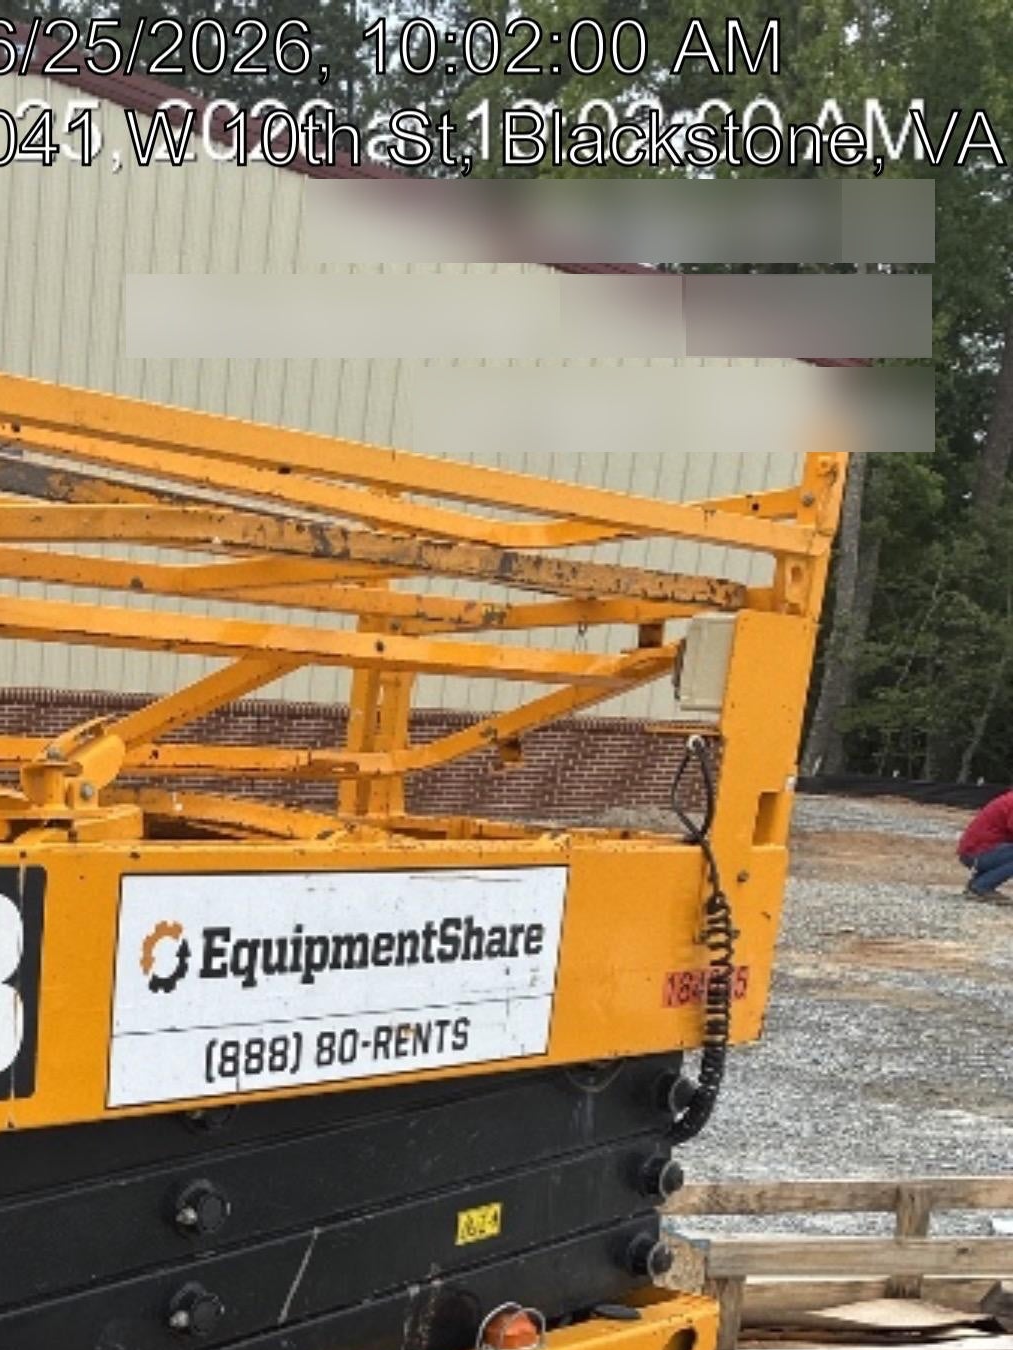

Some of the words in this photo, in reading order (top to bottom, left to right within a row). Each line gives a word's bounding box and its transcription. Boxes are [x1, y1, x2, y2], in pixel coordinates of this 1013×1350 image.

[199, 915, 544, 988] EquipmentShare
[205, 1031, 303, 1083] (888)
[316, 1016, 471, 1068] 80-RENTS
